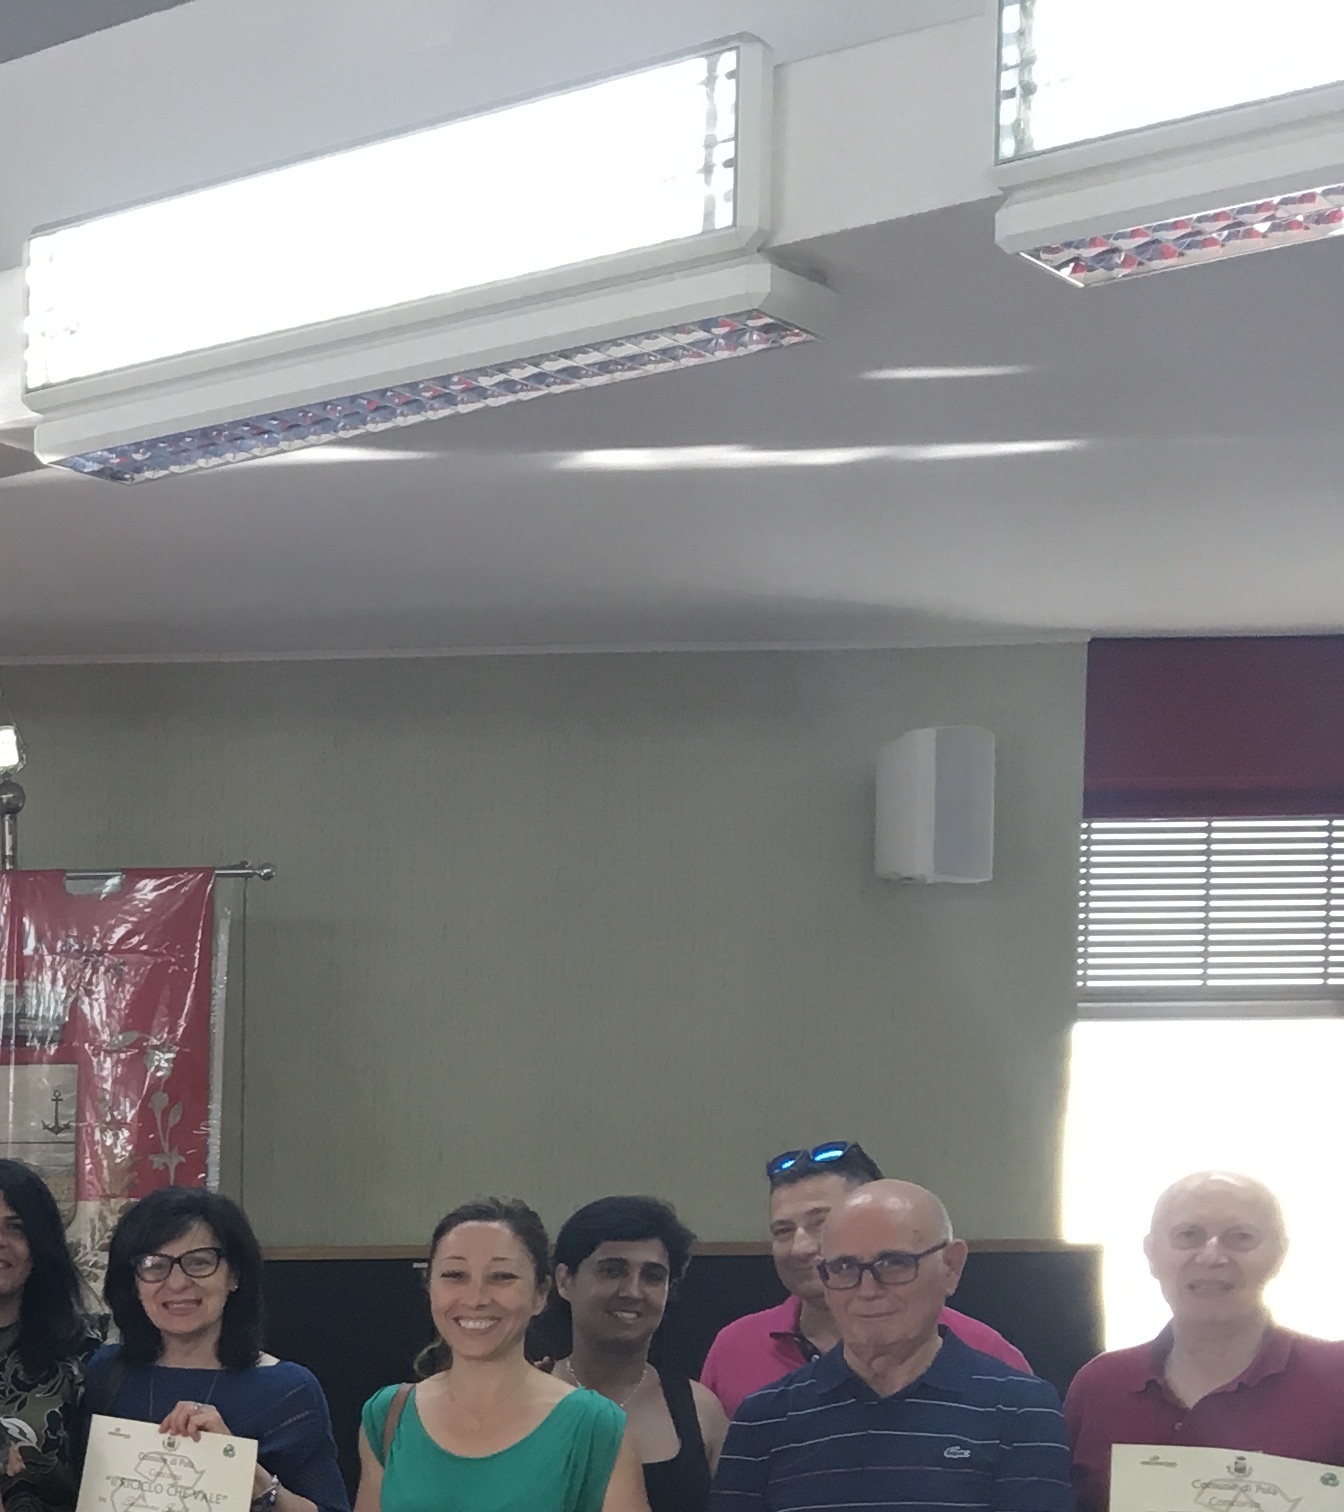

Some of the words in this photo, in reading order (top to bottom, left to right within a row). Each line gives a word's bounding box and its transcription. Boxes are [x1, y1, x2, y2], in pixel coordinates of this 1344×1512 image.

[119, 1477, 163, 1493] RICICLO
[166, 1484, 189, 1499] CHE
[1191, 1479, 1237, 1491] Comune
[1240, 1483, 1251, 1493] di
[1255, 1485, 1278, 1495] Pula
